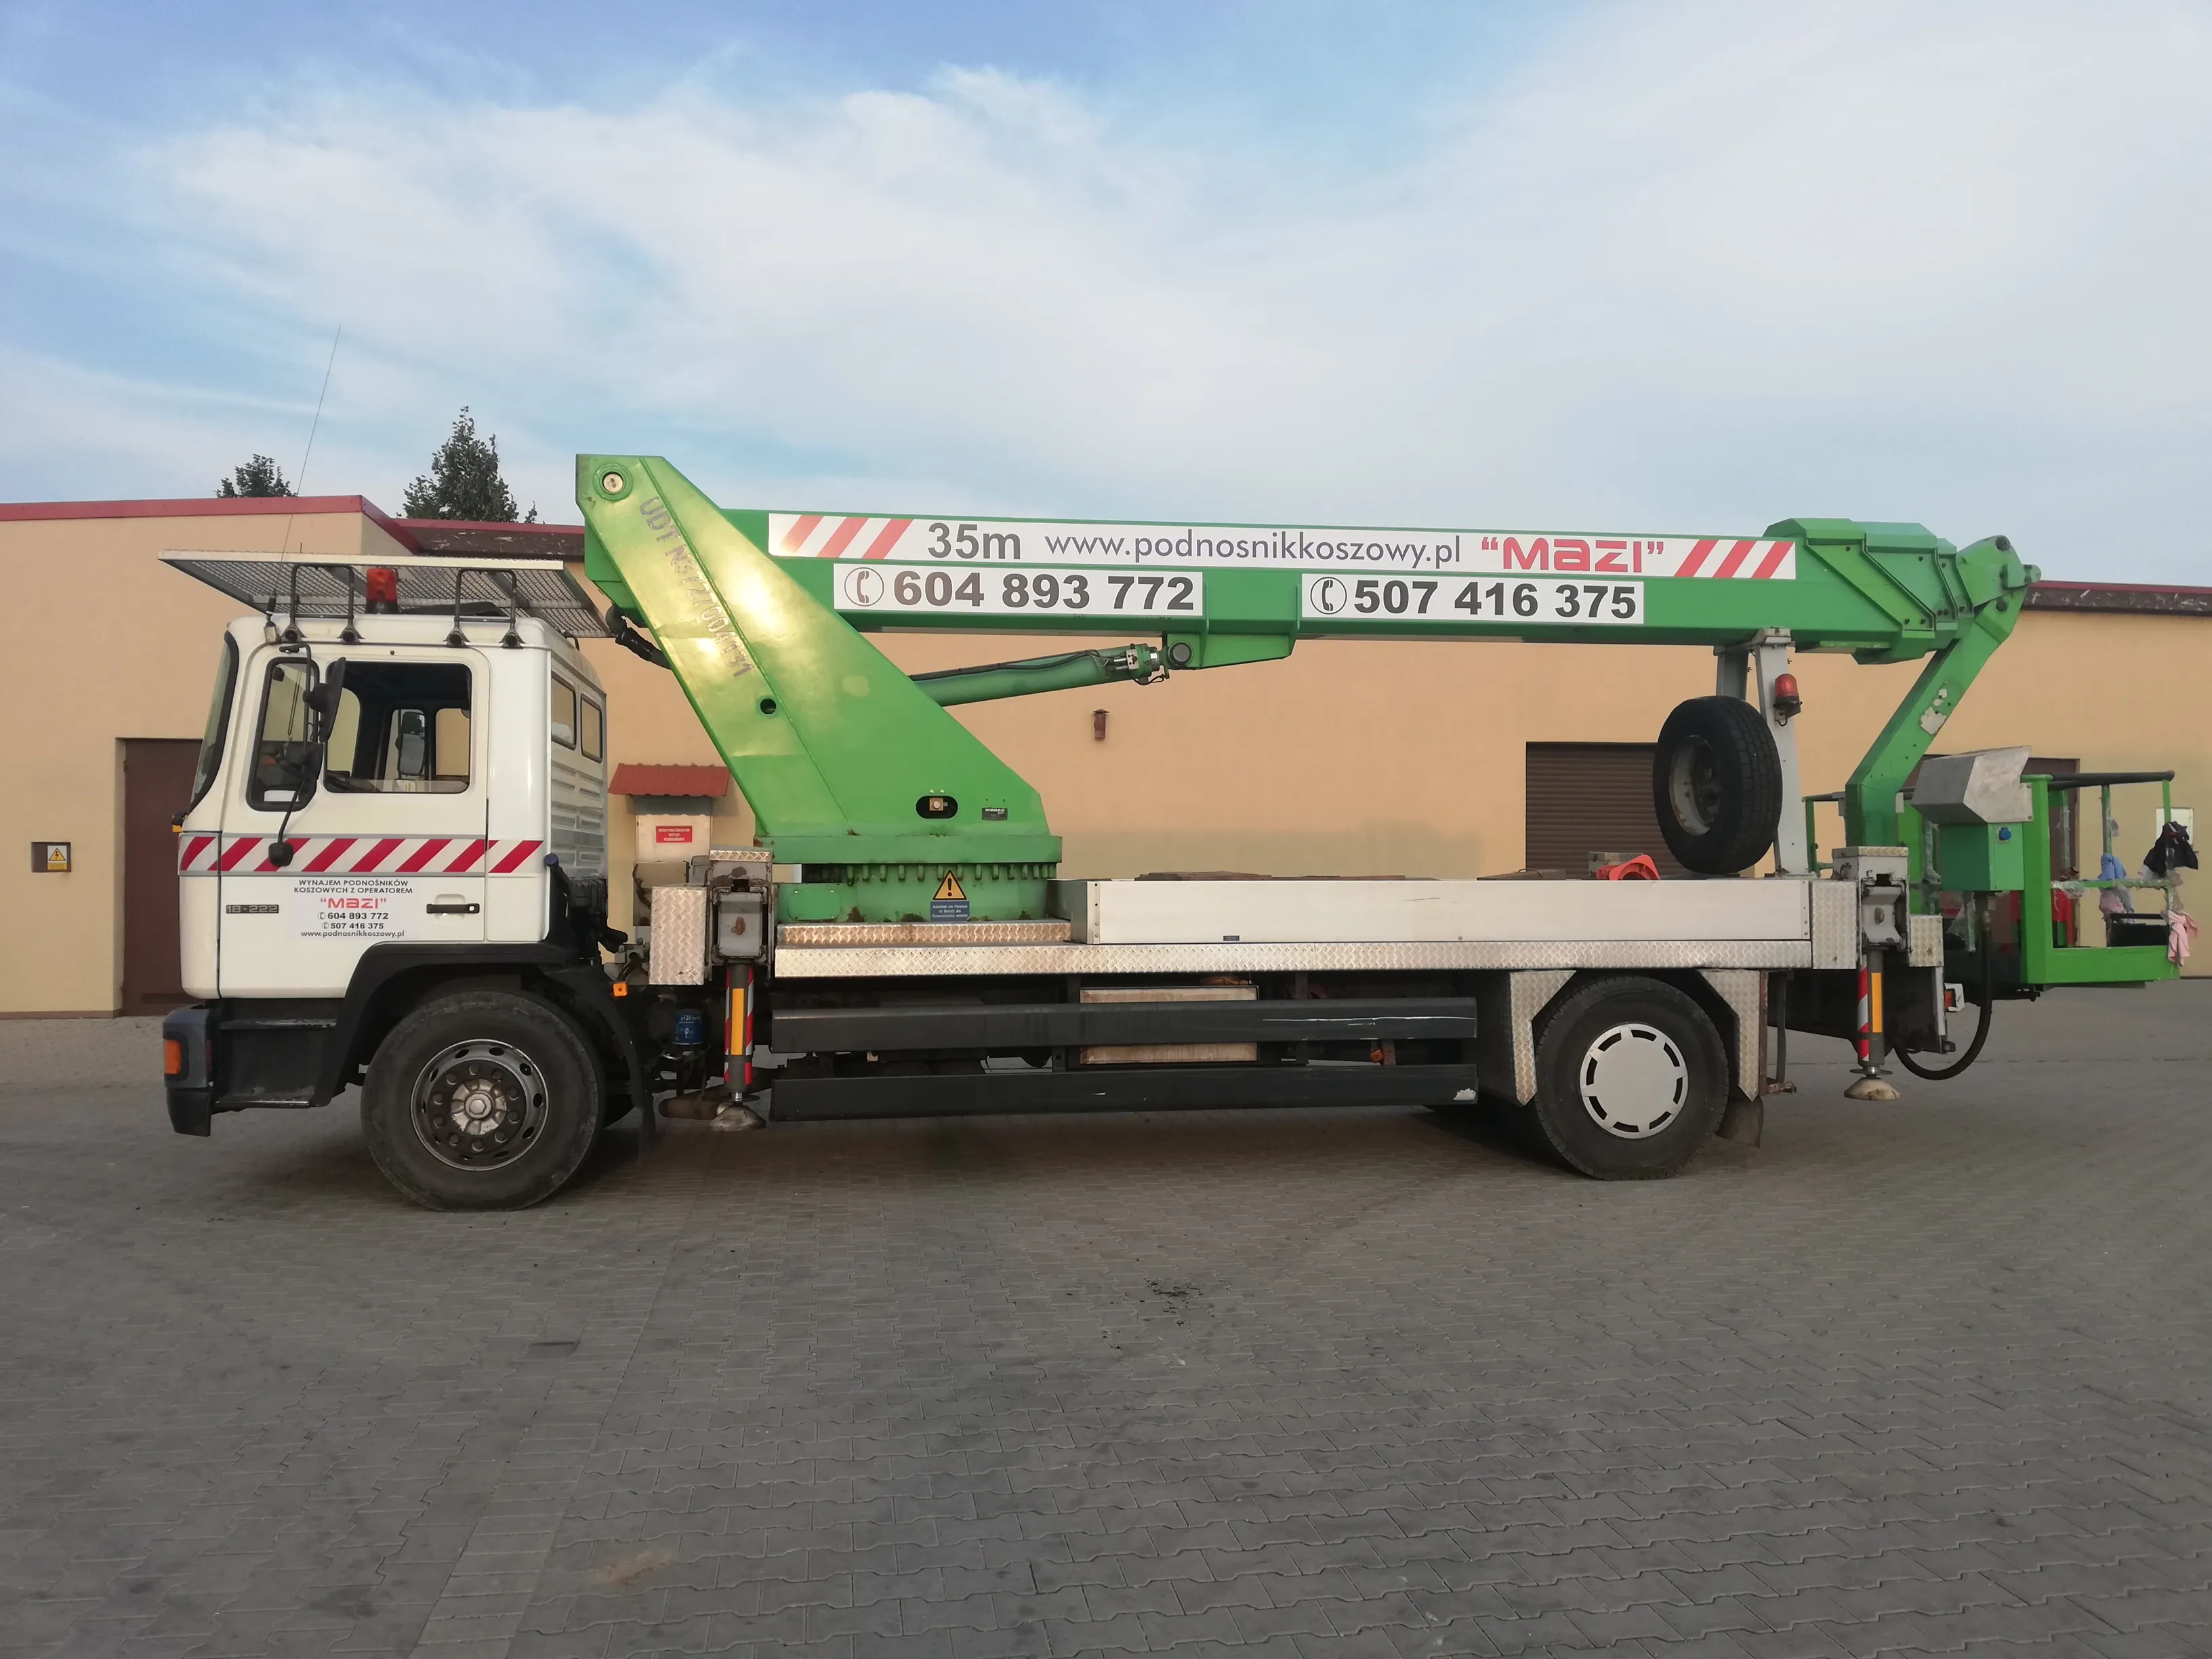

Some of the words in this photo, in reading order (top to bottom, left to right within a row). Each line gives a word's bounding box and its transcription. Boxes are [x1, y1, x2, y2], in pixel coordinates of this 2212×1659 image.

[639, 495, 682, 542] UDT
[927, 522, 1021, 560] 35m
[1044, 528, 1461, 569] www.podnosnikkoszowy.pl
[893, 571, 985, 607] 604
[1001, 573, 1090, 610] 893
[1107, 575, 1195, 611] 772
[1354, 579, 1438, 614] 507
[1454, 581, 1538, 617] 416
[1555, 584, 1637, 619] 375
[343, 878, 409, 886] PODNOŚNIKÓW
[301, 930, 405, 938] www.podnosnikkoszowy.pl
